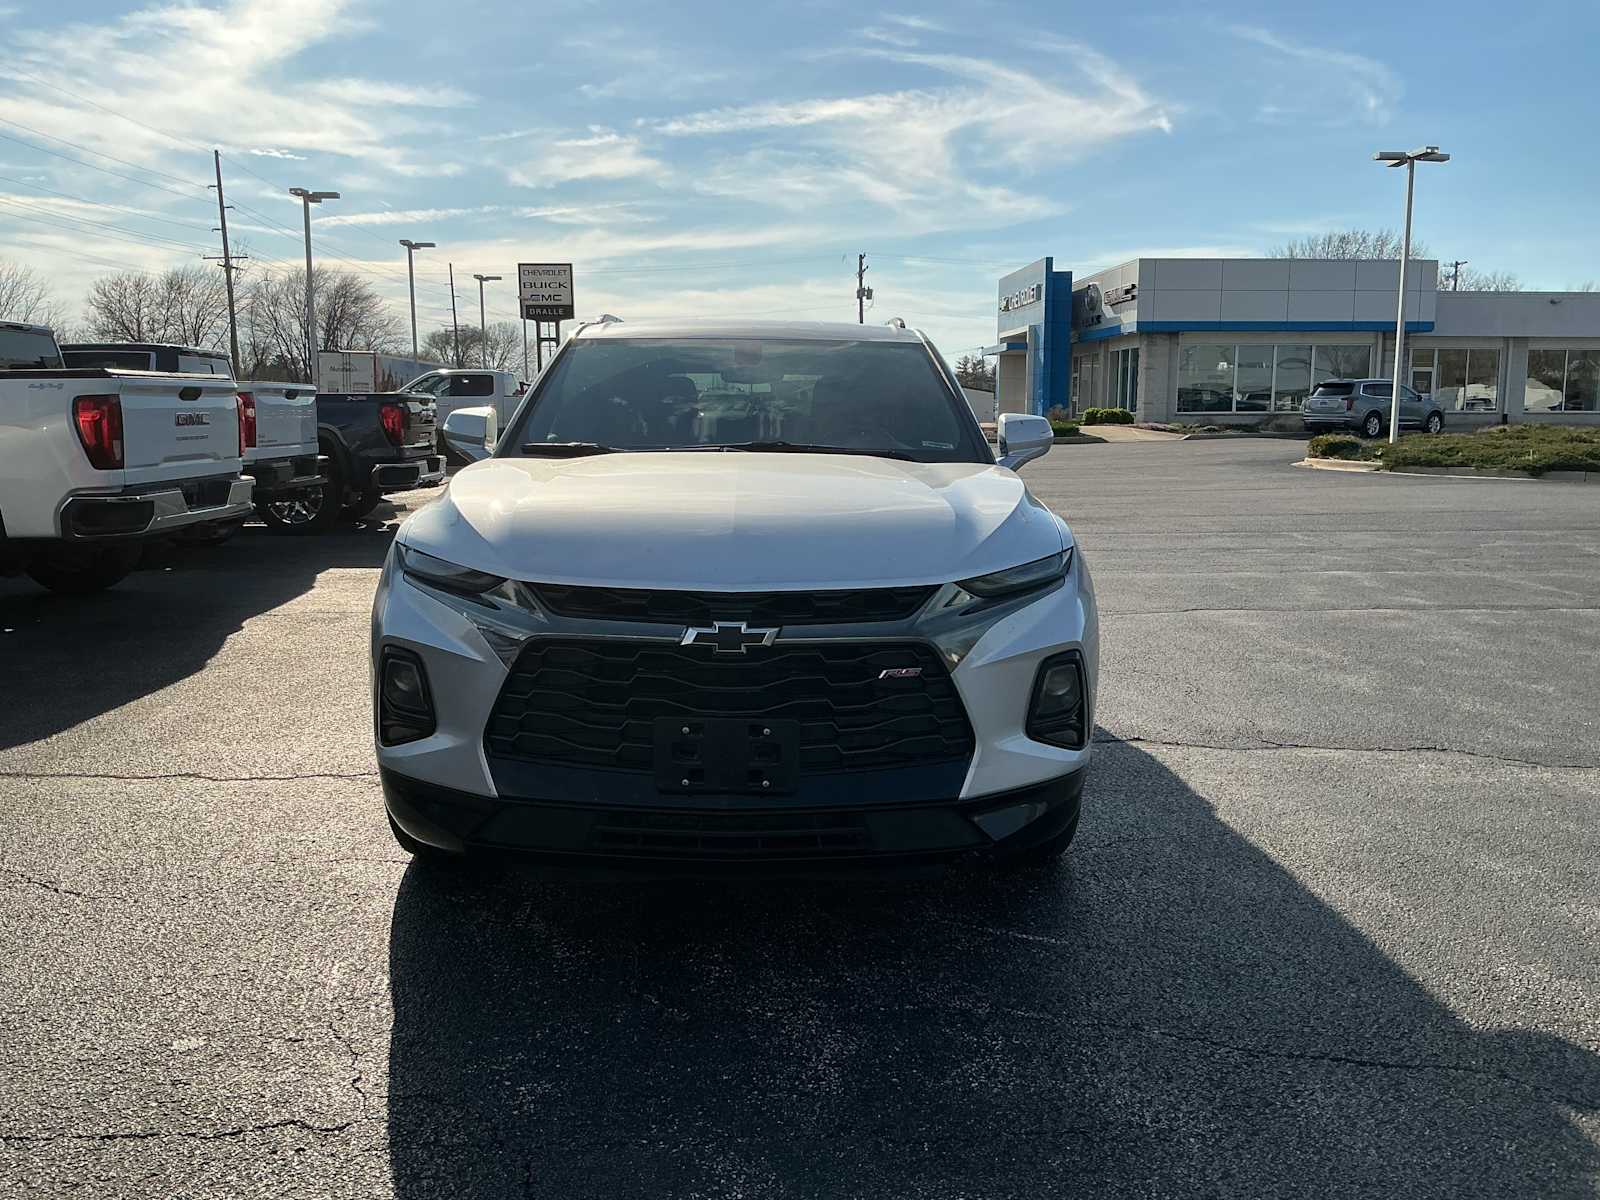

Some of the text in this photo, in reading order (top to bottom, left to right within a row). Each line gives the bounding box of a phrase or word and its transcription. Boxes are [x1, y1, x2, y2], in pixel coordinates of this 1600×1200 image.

[523, 281, 568, 289] BUICK
[529, 294, 562, 302] GMC
[175, 412, 211, 427] GMC
[878, 667, 922, 679] RS
